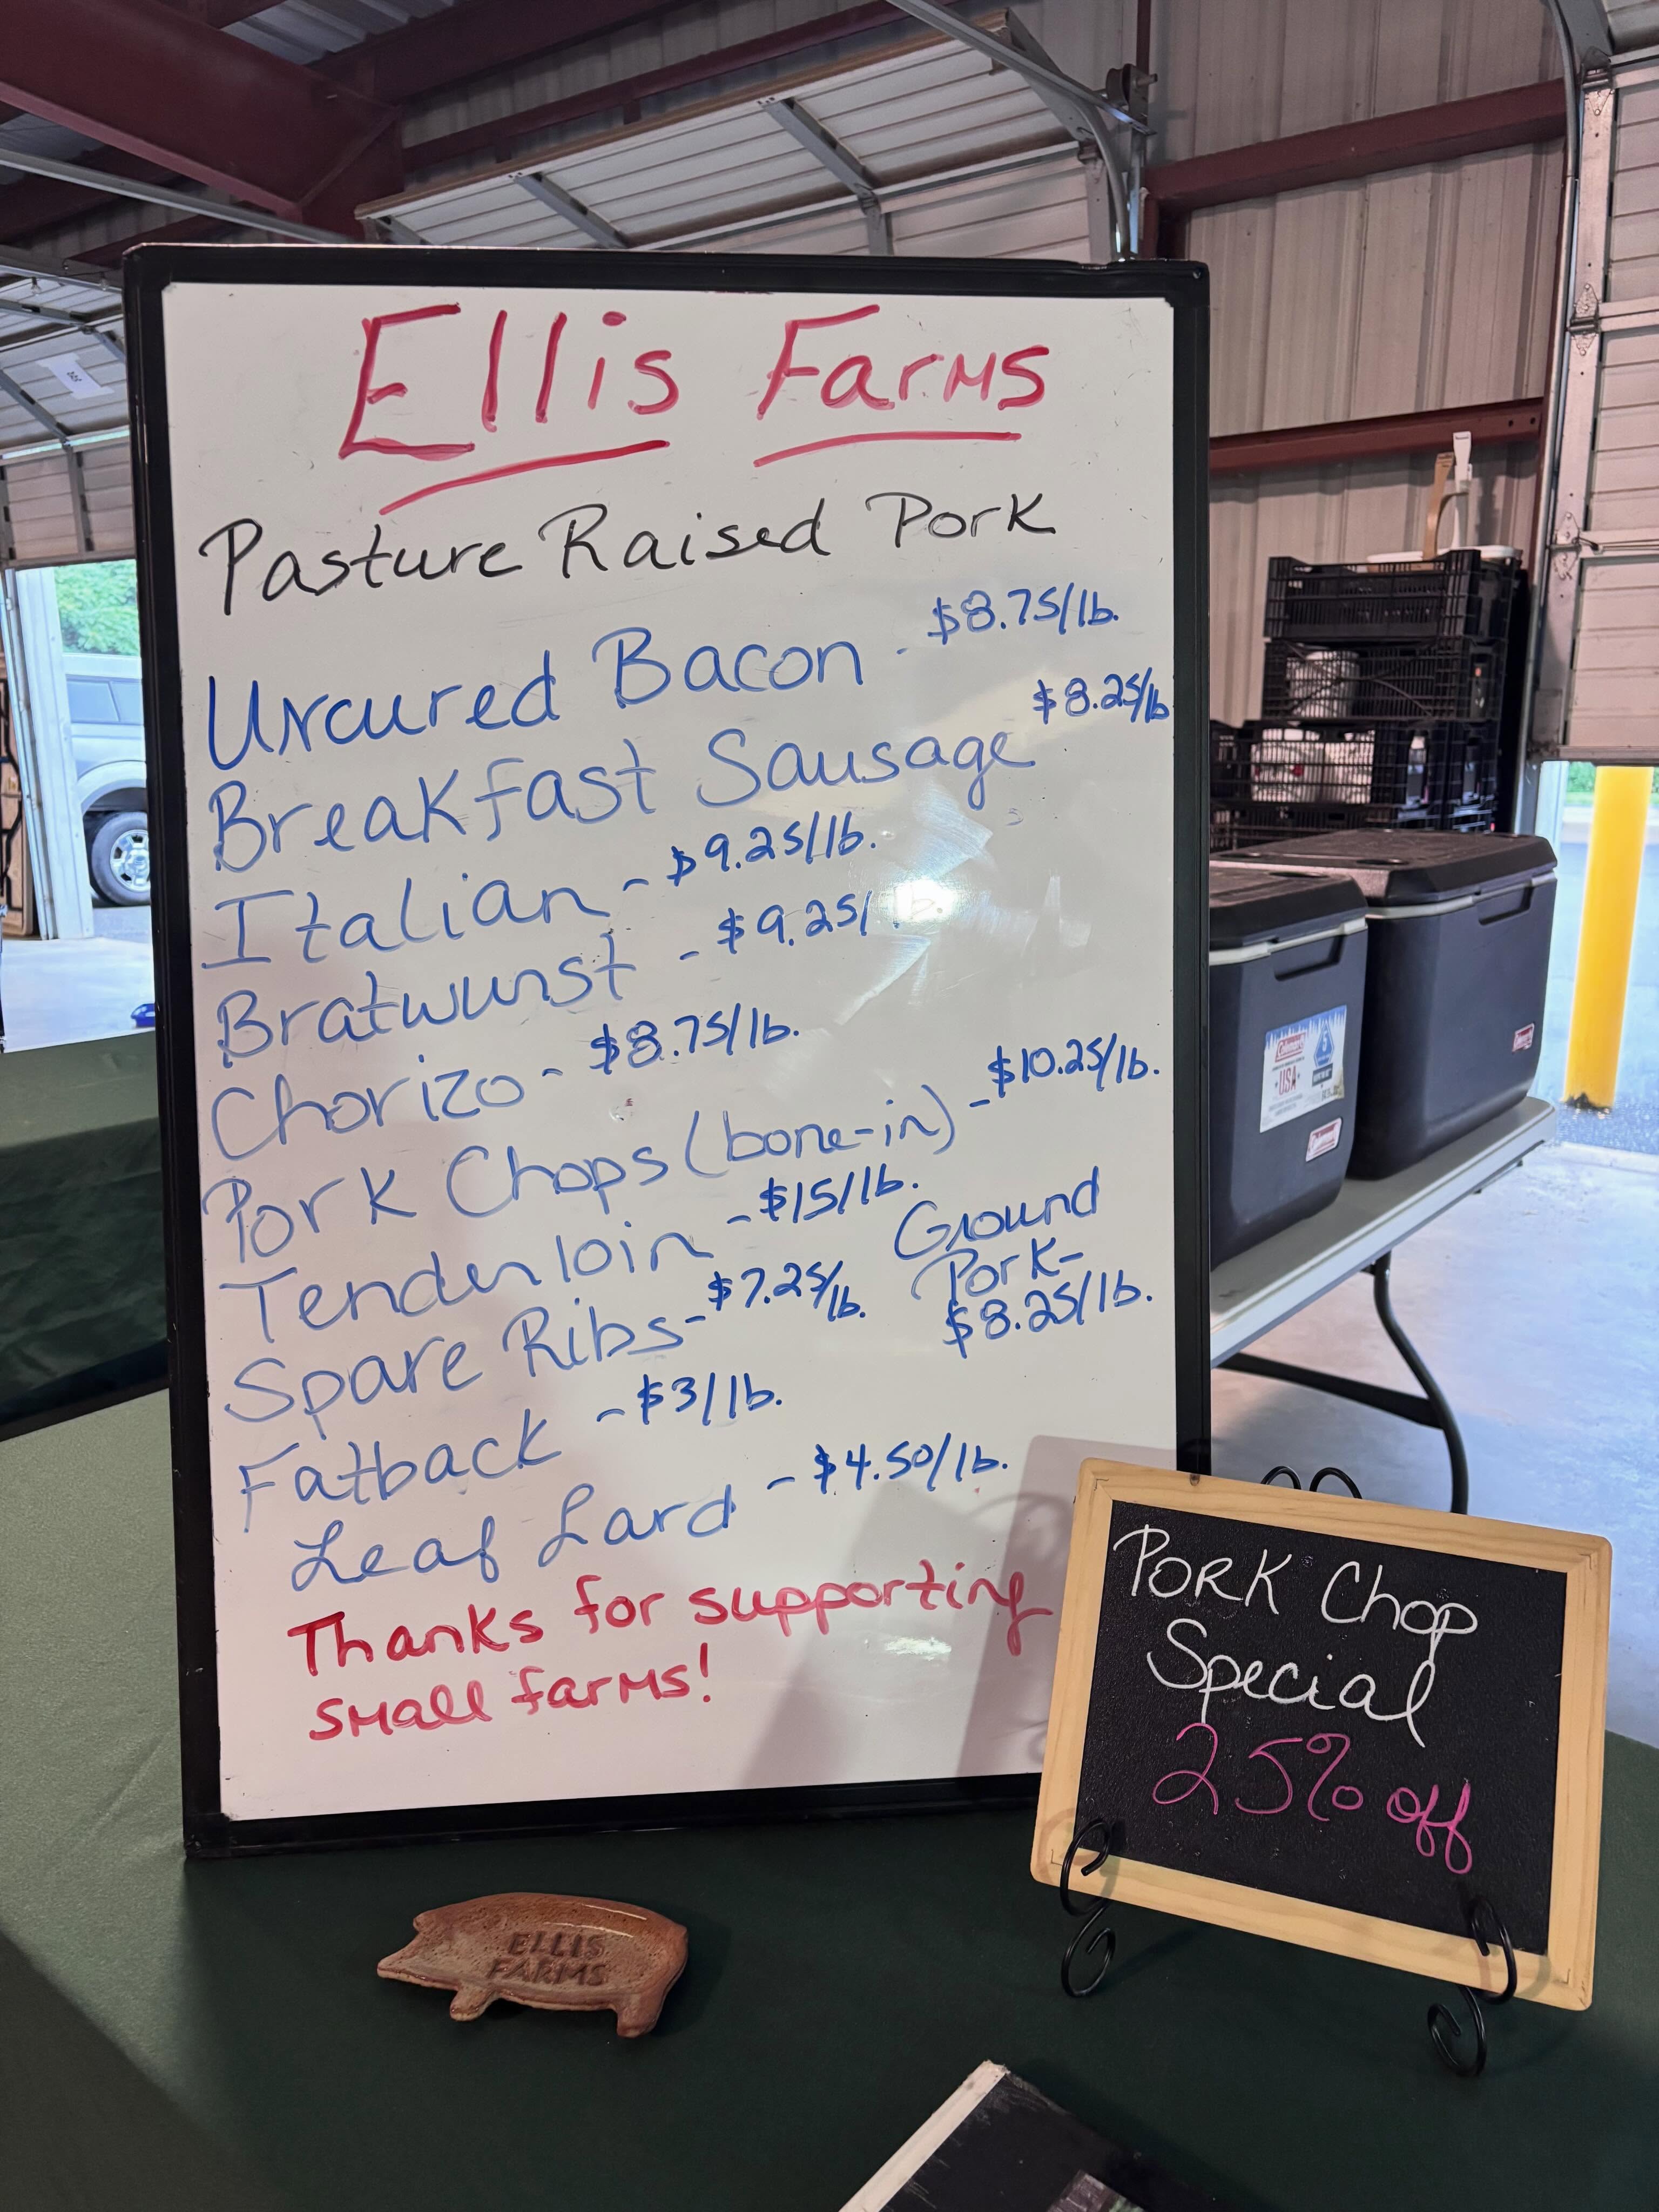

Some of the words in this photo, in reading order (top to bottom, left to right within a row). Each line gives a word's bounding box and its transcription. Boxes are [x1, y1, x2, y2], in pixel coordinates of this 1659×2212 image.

[339, 302, 679, 460] Ellis
[757, 304, 1049, 420] Farms
[199, 518, 523, 615] Pasture
[538, 498, 831, 578] Raised
[866, 492, 1056, 548] Pork
[208, 650, 560, 770] Uncured
[592, 627, 863, 708] Bacon
[927, 583, 1119, 645] $8.75/lb.
[208, 739, 657, 873] Breakfast
[697, 727, 1035, 811] Sausage
[201, 873, 610, 969] Italian
[667, 811, 876, 886] $9.25/lb.
[218, 932, 636, 1068] Bratwurst
[201, 1168, 417, 1263] Pork
[447, 1145, 669, 1217] Chops
[685, 1084, 956, 1177] (bone-in)
[987, 1033, 1160, 1097] $10.25/lb.
[211, 1054, 525, 1160] Chorizo
[590, 1003, 799, 1075] $8.75/lb.
[1279, 1065, 1296, 1095] USA
[219, 1222, 713, 1343] Tenderloin
[759, 1164, 918, 1222] $15/lb.
[894, 1166, 1100, 1260] Ground
[942, 1270, 1152, 1358] $8.25/lb.
[225, 1337, 482, 1439] Spare
[239, 1408, 561, 1533] Fatback
[637, 1373, 782, 1425] $3/lb.
[291, 1515, 498, 1591] Leaf
[538, 1483, 735, 1568] Lard
[813, 1432, 1008, 1494] $4.50/lb.
[287, 1604, 544, 1676] Thanks
[574, 1574, 664, 1634] for
[689, 1559, 1053, 1656] supporting
[1321, 1561, 1478, 1661] Chop
[1147, 1618, 1435, 1748] Special
[1152, 1723, 1364, 1822] 25%
[1386, 1781, 1473, 1874] off
[487, 1957, 610, 1986] FARMS
[508, 1931, 604, 1959] ELLIS
